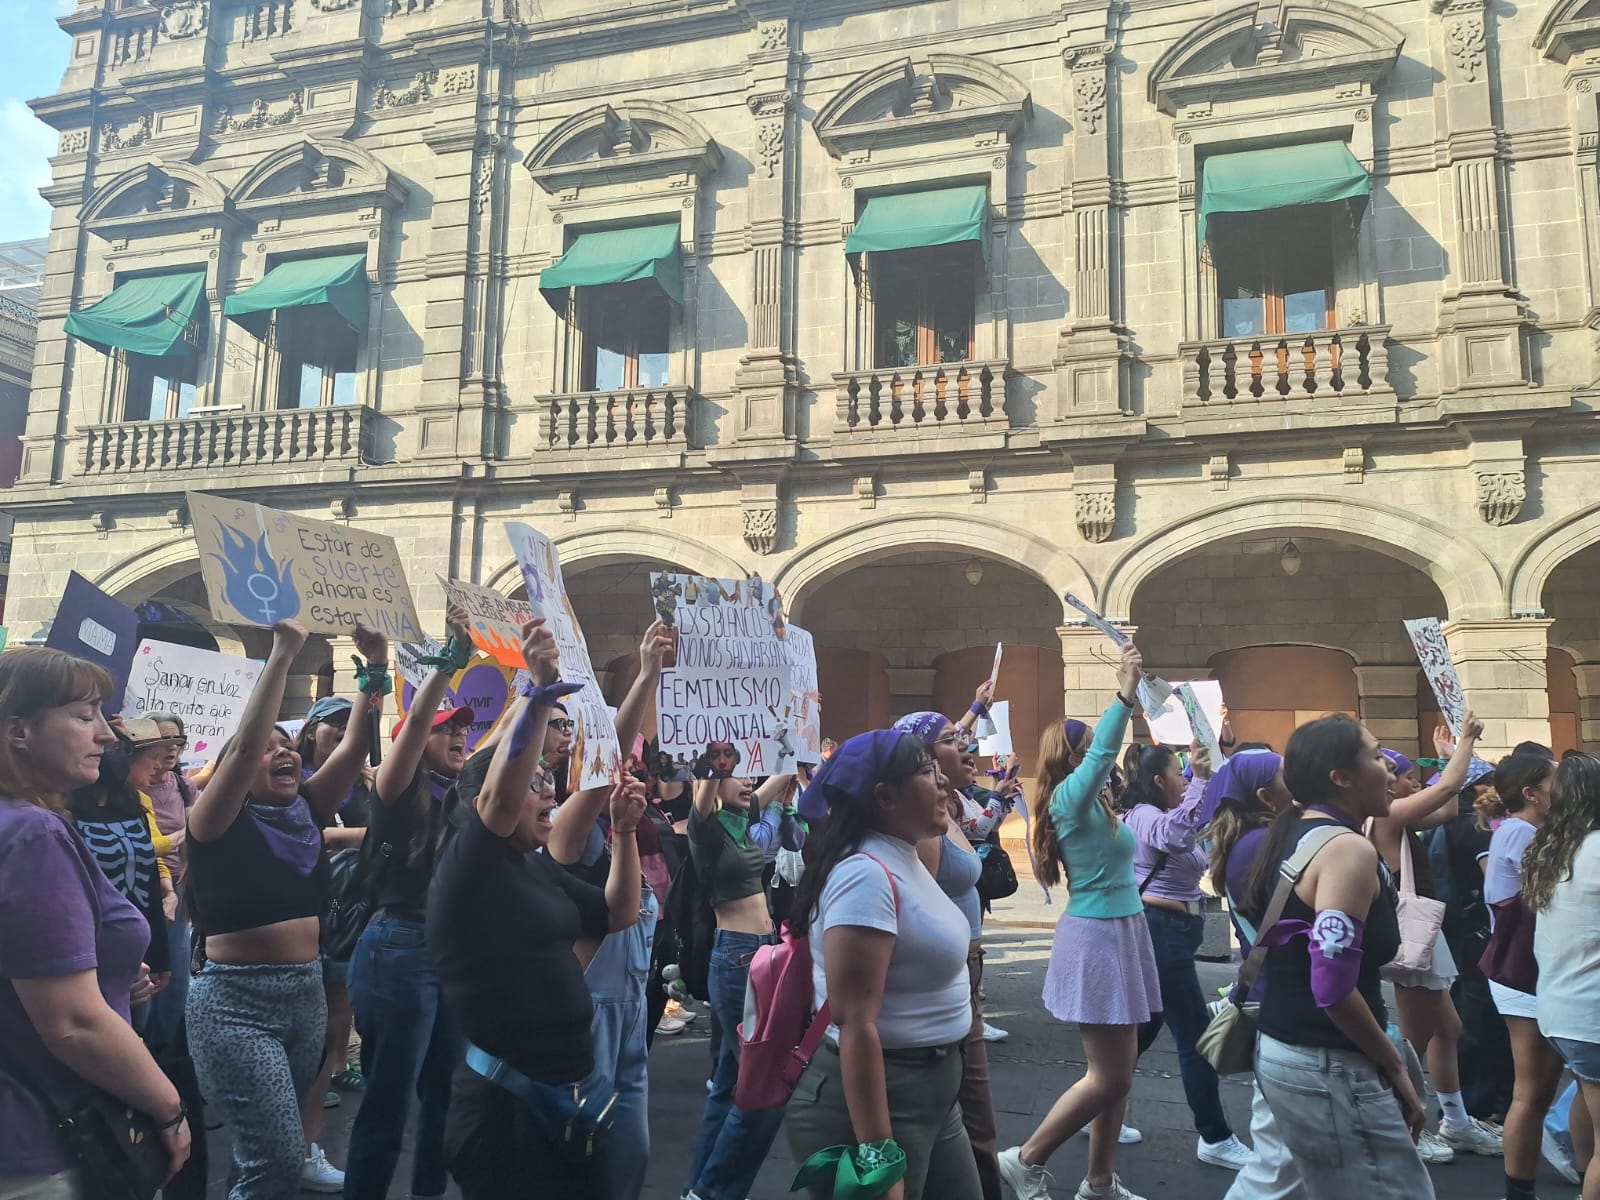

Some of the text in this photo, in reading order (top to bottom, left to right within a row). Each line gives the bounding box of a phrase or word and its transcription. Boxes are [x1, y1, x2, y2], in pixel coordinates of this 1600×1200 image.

[298, 528, 383, 559] Estar de
[312, 577, 393, 603] ahora es
[310, 604, 419, 640] estar VIVA
[678, 637, 787, 669] NO NOS SALVARAN
[145, 659, 196, 689] Sanar
[197, 678, 215, 693] en
[660, 671, 781, 708] FEMINISMO
[661, 713, 771, 745] DECOLONIAL
[744, 741, 765, 774] YA
